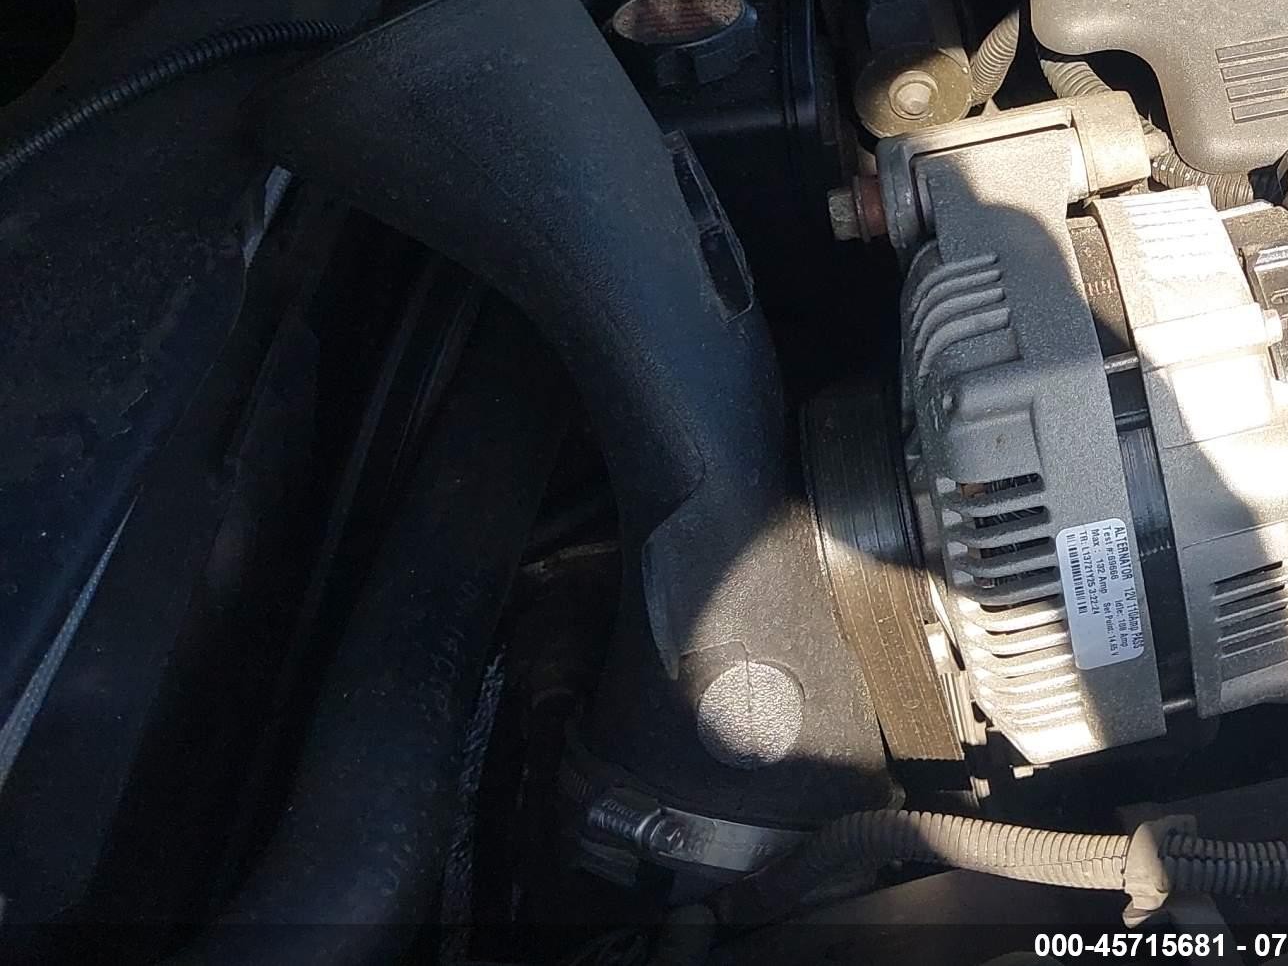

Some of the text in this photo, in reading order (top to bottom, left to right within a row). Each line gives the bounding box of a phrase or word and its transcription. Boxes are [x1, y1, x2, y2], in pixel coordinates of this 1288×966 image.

[1096, 575, 1109, 594] Amp
[1102, 526, 1113, 545] Test
[1118, 632, 1129, 647] Amp
[1113, 526, 1132, 580] ALTERNATOR
[1123, 586, 1135, 601] 12V
[1131, 632, 1144, 648] PASS
